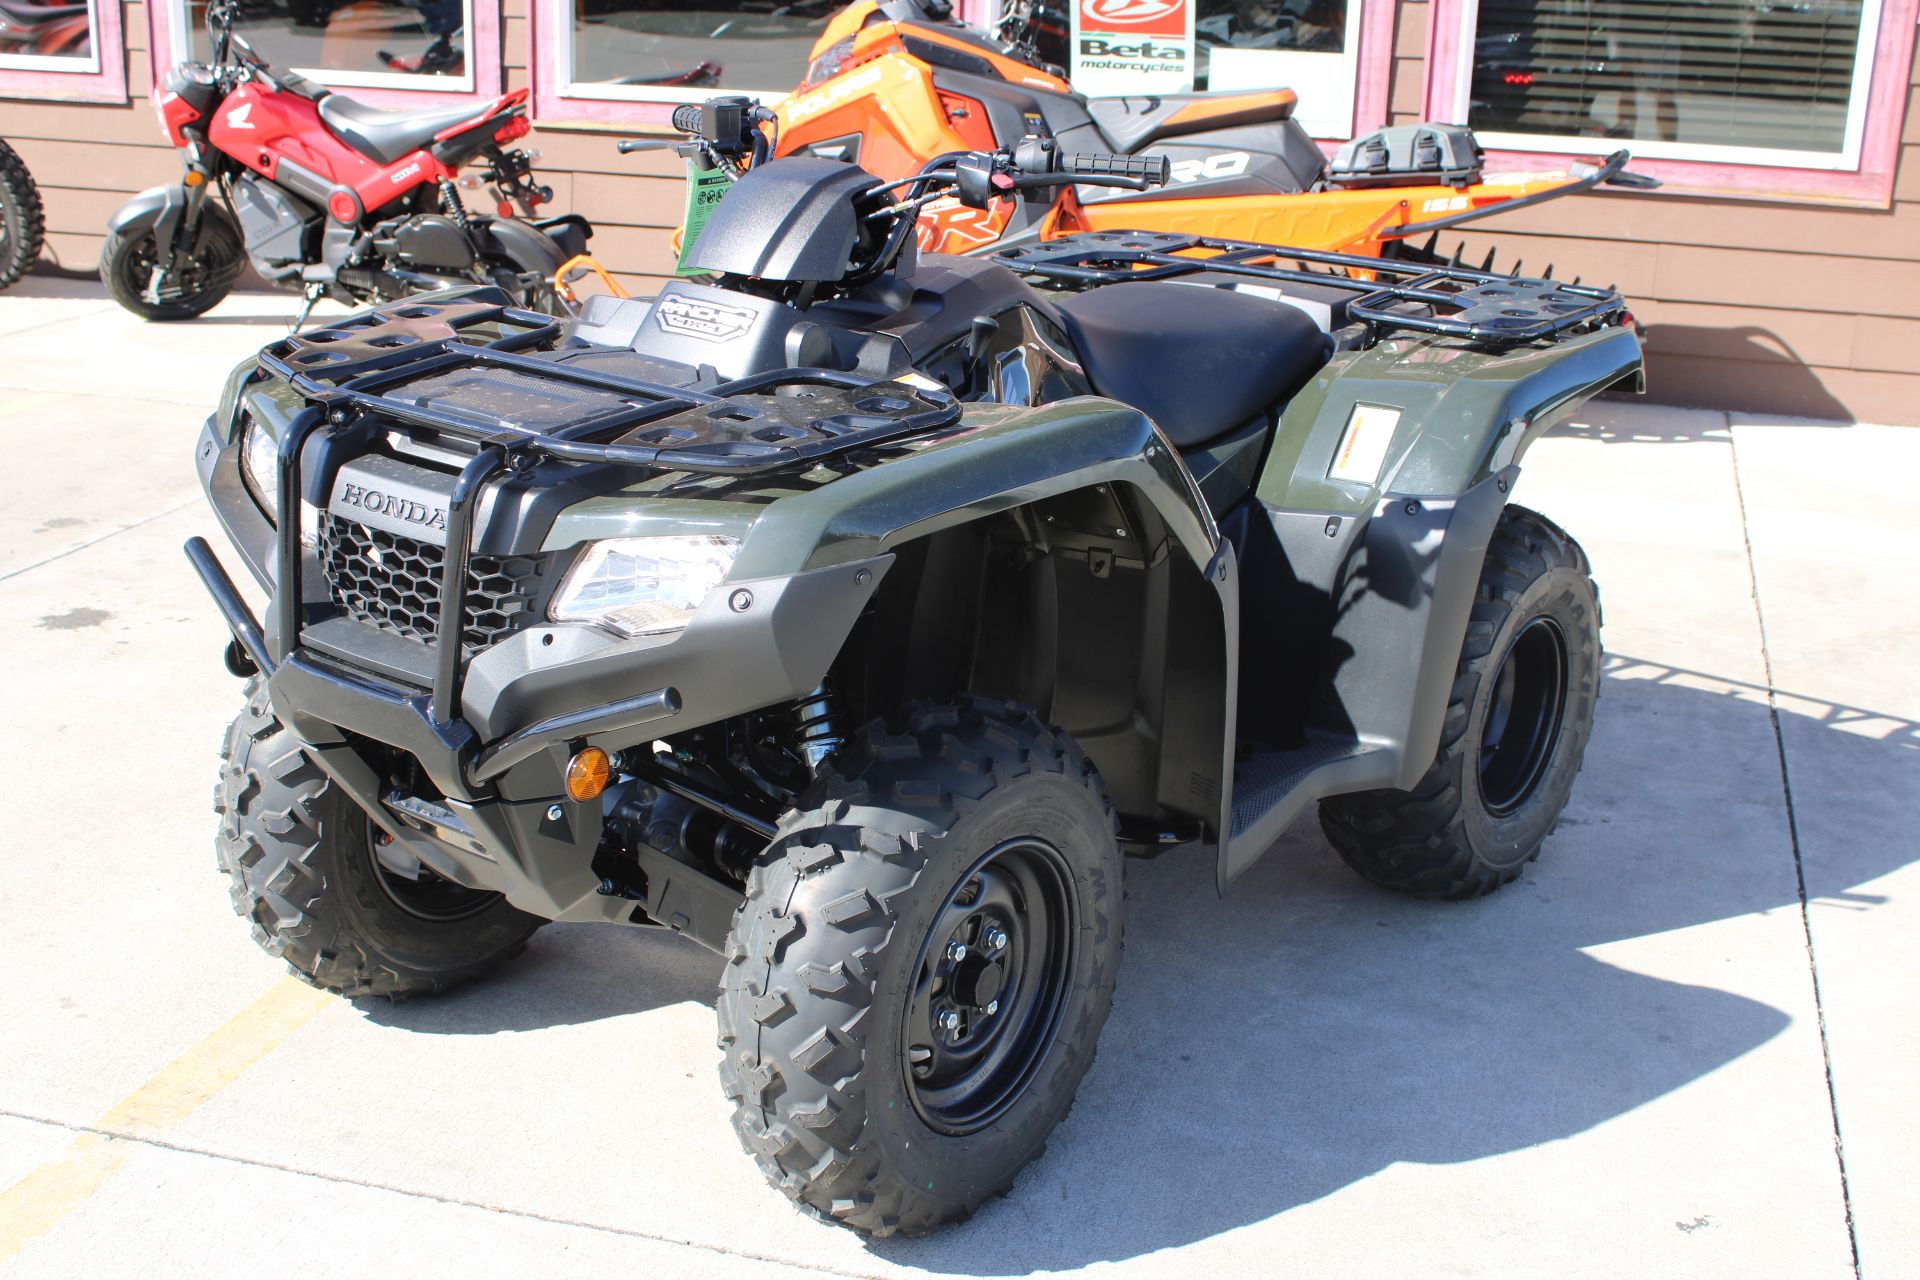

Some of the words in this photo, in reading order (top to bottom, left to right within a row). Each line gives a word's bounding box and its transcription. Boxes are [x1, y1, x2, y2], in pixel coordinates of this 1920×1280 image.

[1080, 39, 1185, 60] Beta
[1080, 60, 1185, 73] motorcycles
[787, 66, 882, 124] POLARIS
[341, 483, 448, 532] HONDA
